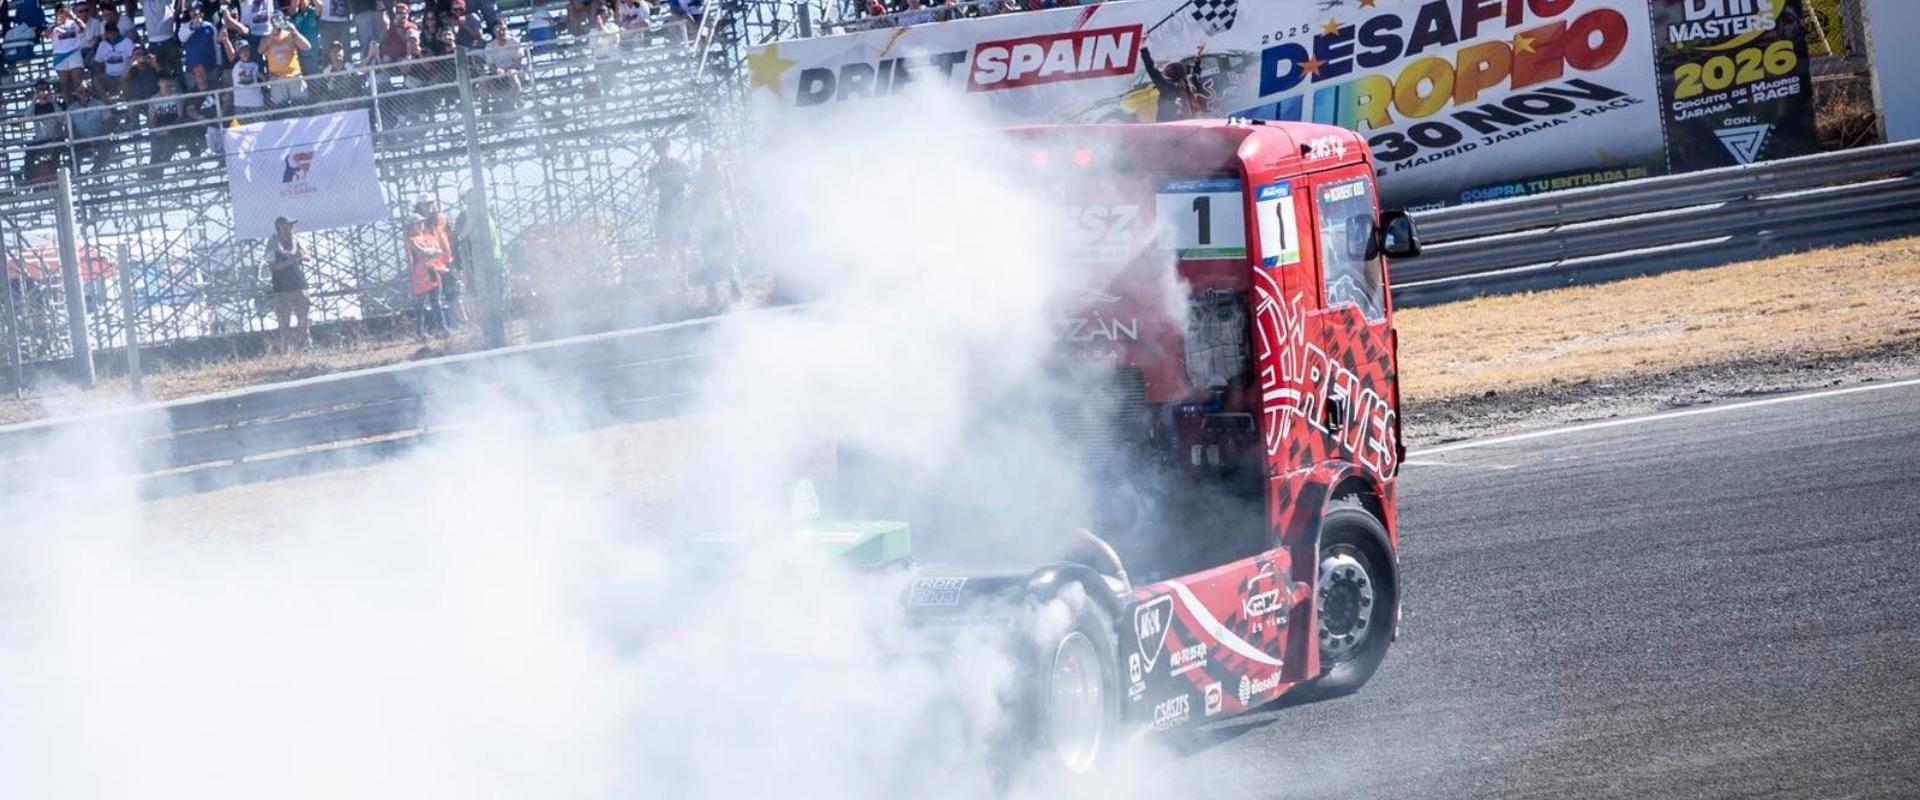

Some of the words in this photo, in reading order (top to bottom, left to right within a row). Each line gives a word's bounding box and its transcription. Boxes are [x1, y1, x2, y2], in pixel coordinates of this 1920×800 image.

[1261, 24, 1310, 44] 2025
[1669, 13, 1776, 44] MASTERS
[974, 32, 1134, 85] SPAIN
[1673, 40, 1797, 100] 2026
[1368, 121, 1463, 163] 30
[1464, 78, 1629, 136] NOV
[1674, 102, 1733, 121] JARAMA
[1753, 84, 1801, 104] RACE
[1395, 143, 1478, 172] MADRID
[1483, 118, 1566, 146] JARAMA
[1584, 96, 1646, 120] RACE
[1460, 182, 1526, 201] COMPRA
[1527, 180, 1550, 192] TU
[1552, 169, 1625, 190] ENTRADA
[1192, 195, 1211, 245] 1
[1276, 202, 1286, 250] 1
